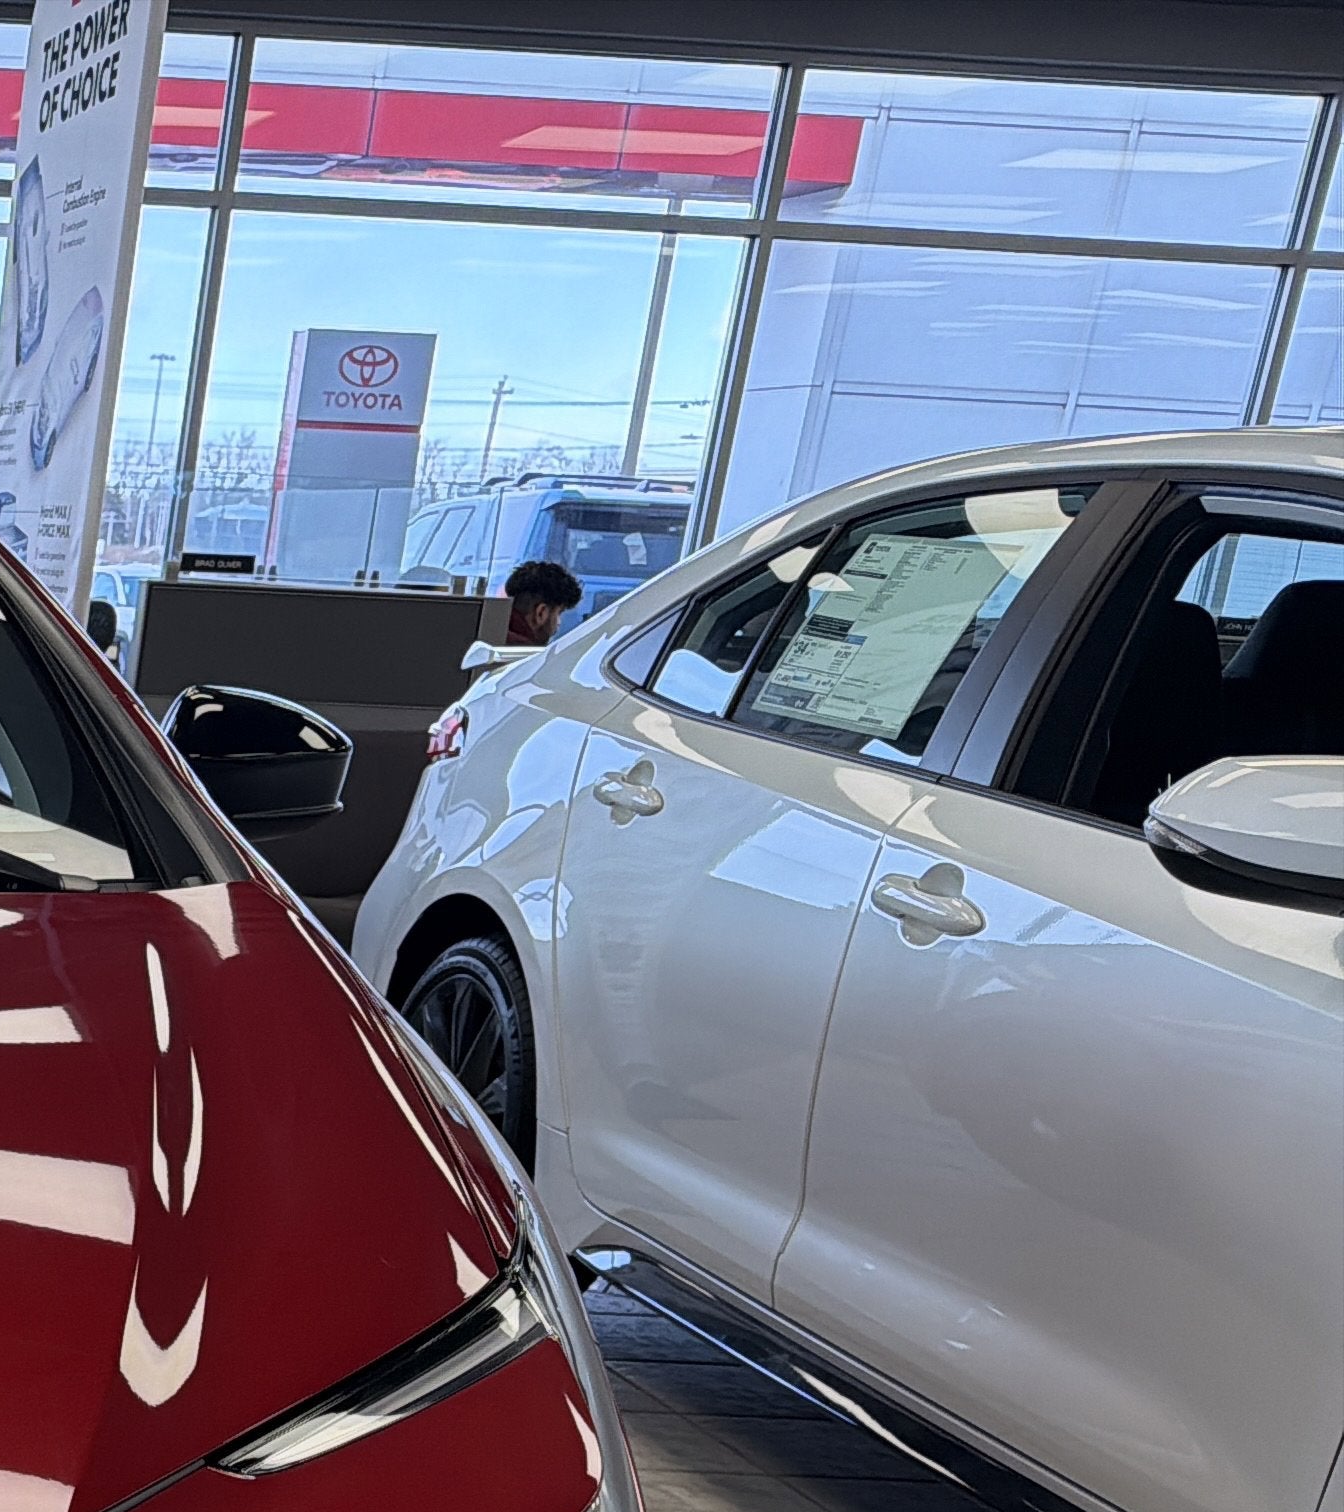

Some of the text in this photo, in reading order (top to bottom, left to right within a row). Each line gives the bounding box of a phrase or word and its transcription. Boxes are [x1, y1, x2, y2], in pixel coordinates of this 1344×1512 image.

[42, 0, 131, 82] THE POWER
[39, 51, 120, 133] OF CHOICE
[322, 391, 403, 410] TOYOTA
